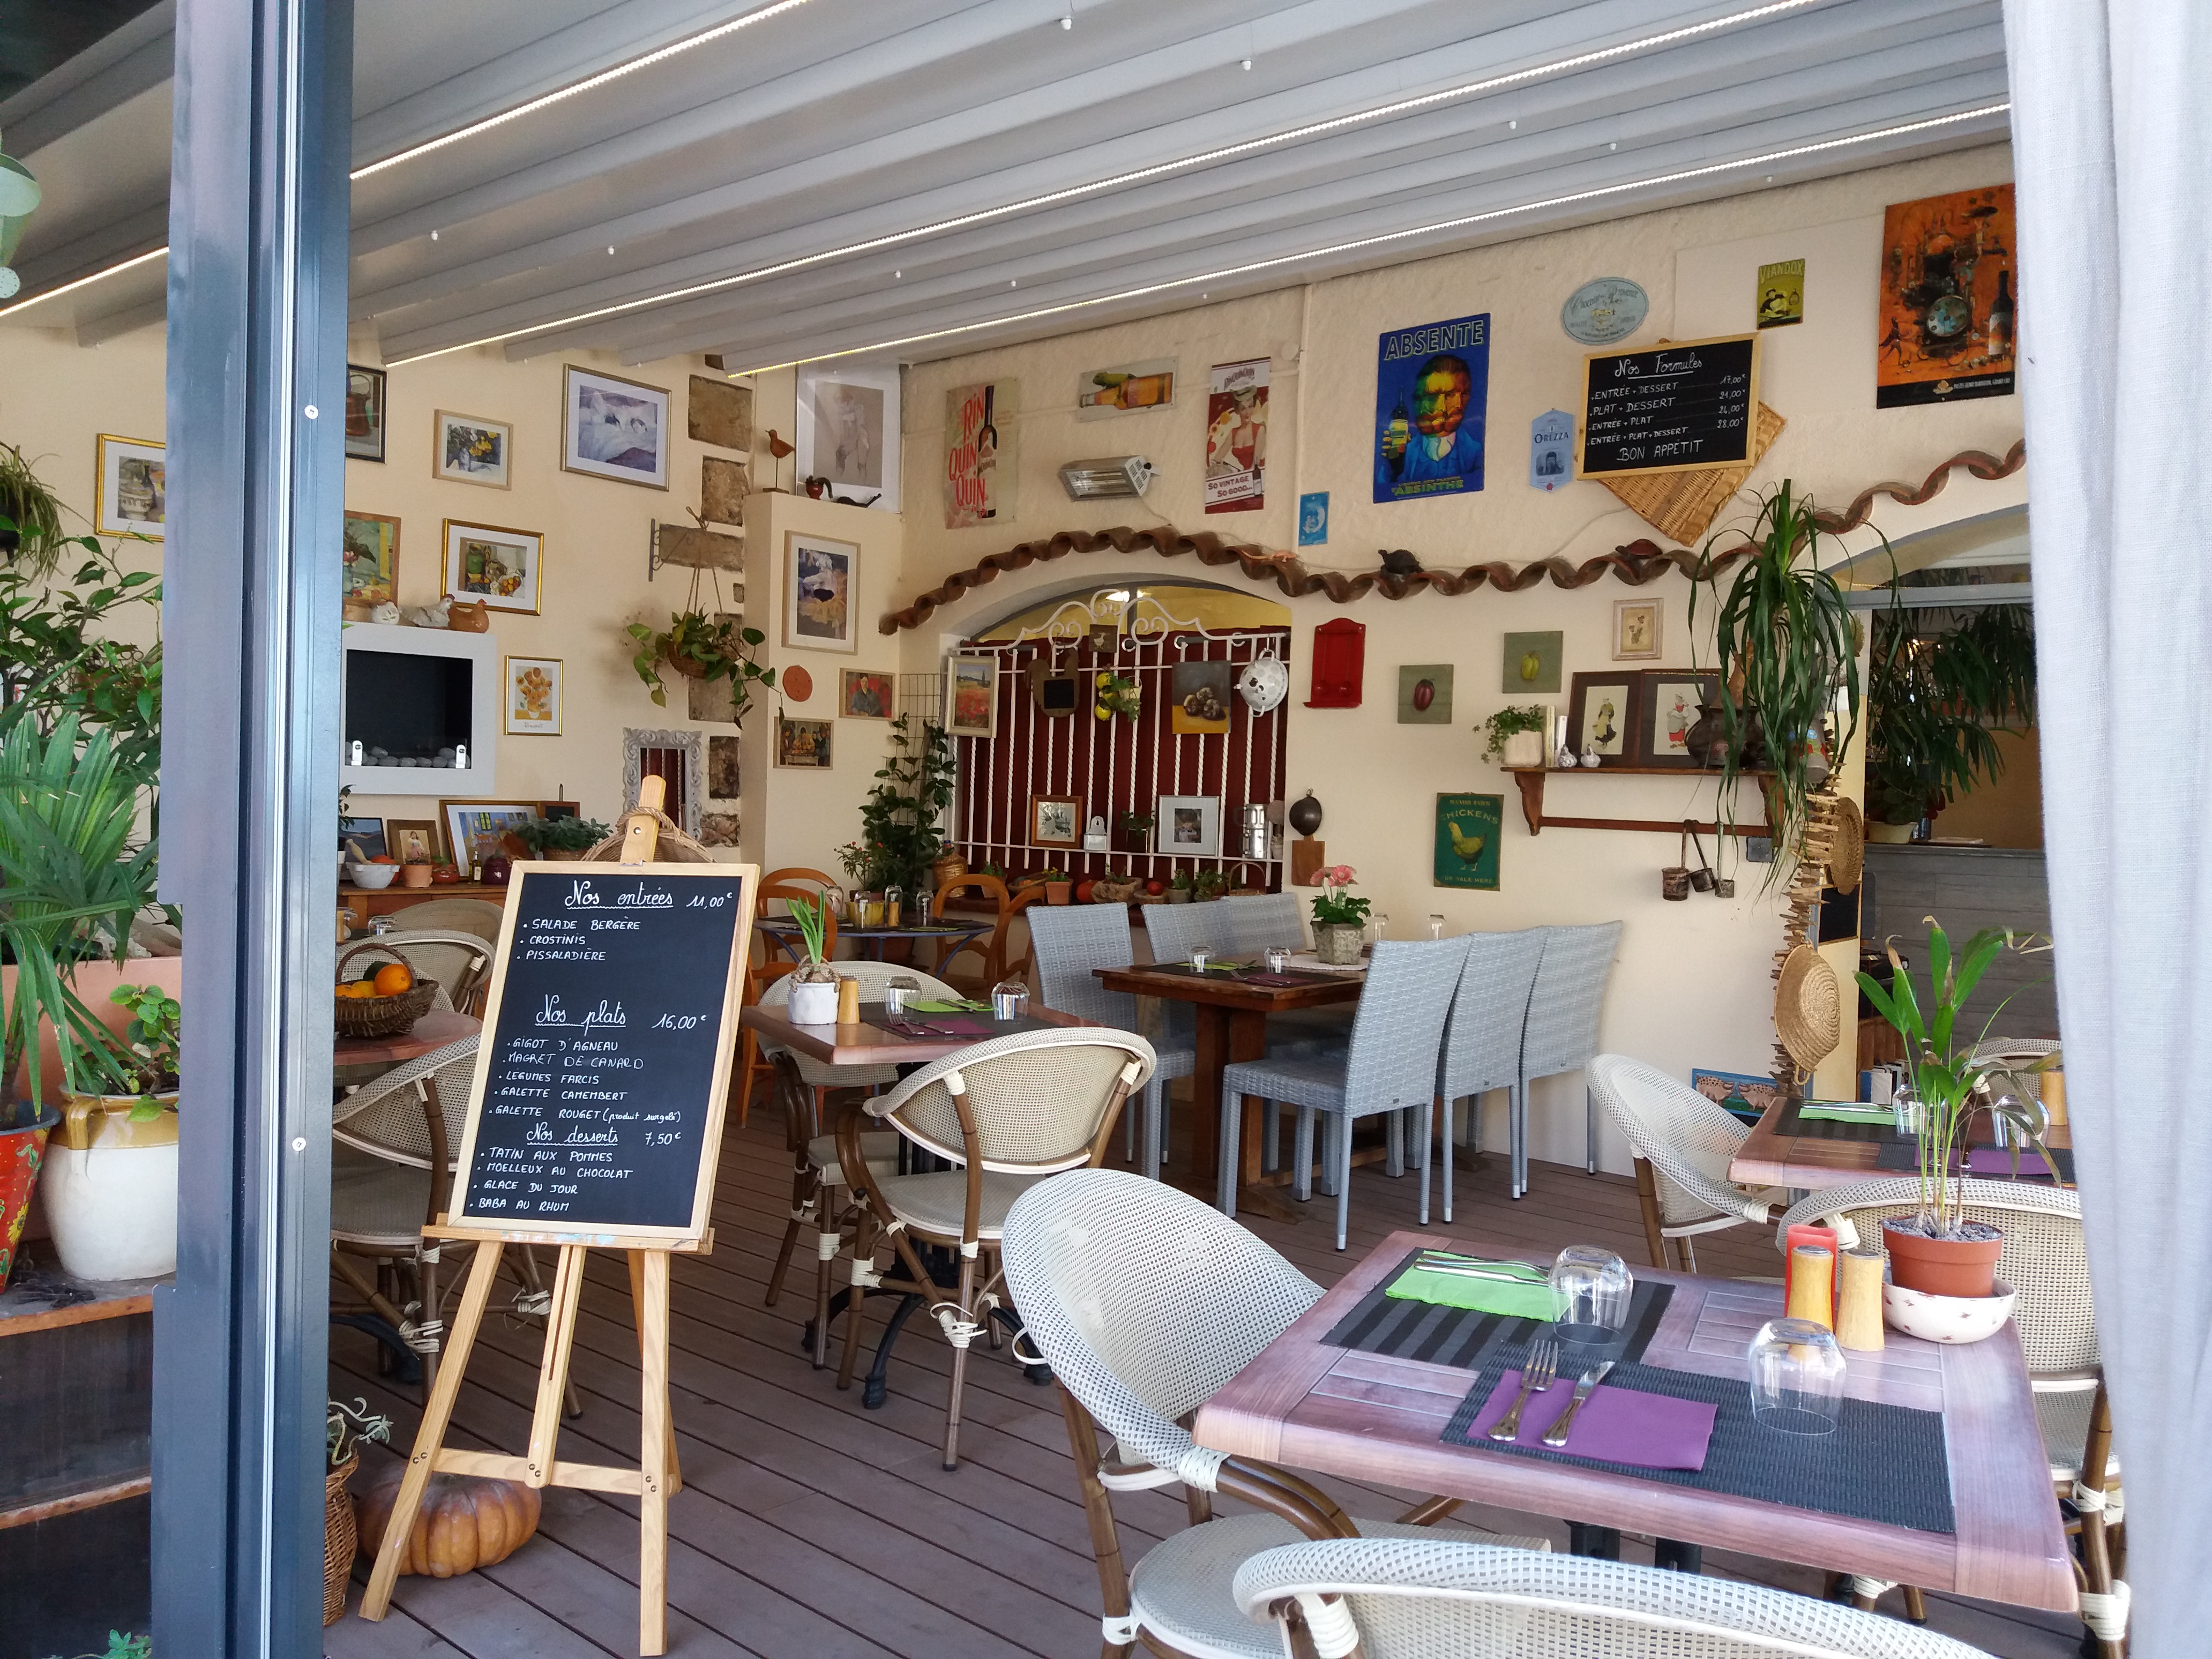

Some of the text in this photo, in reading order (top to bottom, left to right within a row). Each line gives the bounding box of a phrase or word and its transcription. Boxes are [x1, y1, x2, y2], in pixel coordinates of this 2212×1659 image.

[1759, 260, 1804, 285] VIANDOX
[1384, 319, 1484, 361] ABSENTE
[1615, 352, 1702, 377] Nos Formules
[1595, 385, 1630, 400] ENTRÉE
[1639, 382, 1679, 394] DESSERT
[1594, 403, 1617, 416] PLAT
[1626, 397, 1676, 412] DESSERT
[1592, 417, 1621, 430] ENTRÉE
[1631, 416, 1654, 425] PLAT
[1590, 432, 1620, 445] ENTRÉE
[1629, 433, 1648, 441] PLAT
[1654, 427, 1688, 438] DESSERT
[1616, 438, 1703, 461] BON APPÉTIT
[1219, 475, 1249, 487] VINTAGE
[565, 880, 673, 907] Nos entrées
[532, 916, 641, 931] SALADE BERGÈRE
[529, 933, 586, 945] CROSTINIS
[526, 947, 607, 961] PISSALADIÈRE
[536, 994, 626, 1036] Nos plats
[513, 1036, 549, 1049] GIGOT
[509, 1052, 556, 1065] MAGRET
[591, 1057, 644, 1070] CANARD
[506, 1068, 599, 1085] LÉGUMES FARCIS
[501, 1086, 628, 1101] GALETTE CAMEMBERT
[495, 1104, 543, 1117] GALETTE
[559, 1109, 602, 1120] ROUGET
[527, 1122, 618, 1143] Nos desserts
[489, 1147, 613, 1162] TATIN AUX POMMES
[487, 1162, 633, 1179] MOELLEUX AU CHOCOLAT
[484, 1179, 578, 1194] GLACE DU JOUR
[479, 1198, 570, 1212] BABA AU RHUM
